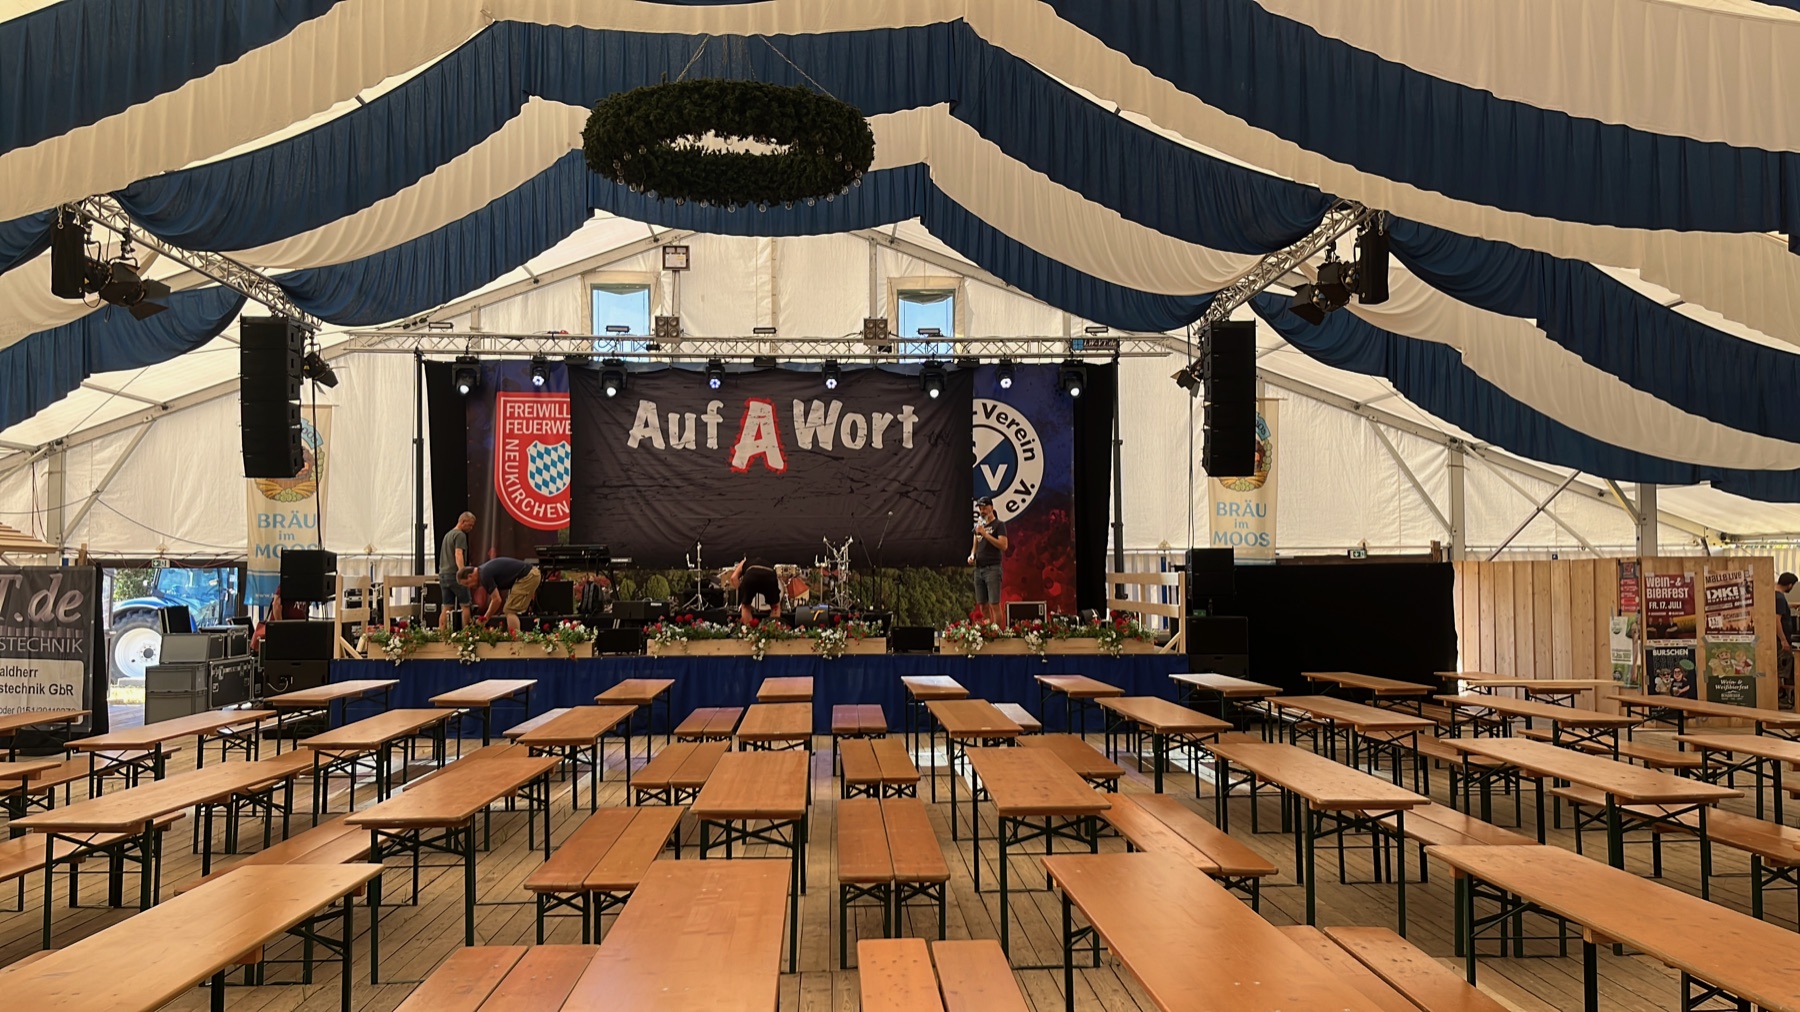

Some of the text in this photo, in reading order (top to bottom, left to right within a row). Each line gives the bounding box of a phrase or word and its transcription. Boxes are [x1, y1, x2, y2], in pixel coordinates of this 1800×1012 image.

[506, 403, 571, 418] FREIWILL
[505, 419, 573, 434] FEUERWE
[627, 398, 919, 473] Auf A Wort
[504, 439, 570, 518] NEUKIRCHEN
[1005, 478, 1036, 513] e.V.
[1216, 499, 1267, 518] BRÄU
[257, 510, 317, 529] BRÄU
[1234, 518, 1249, 529] im
[278, 530, 295, 541] im
[1213, 531, 1270, 548] MOOS
[1668, 601, 1682, 610] JULI
[1653, 648, 1688, 656] BURSCHEN
[0, 665, 38, 678] aldherr
[0, 683, 74, 696] stechnik GbR
